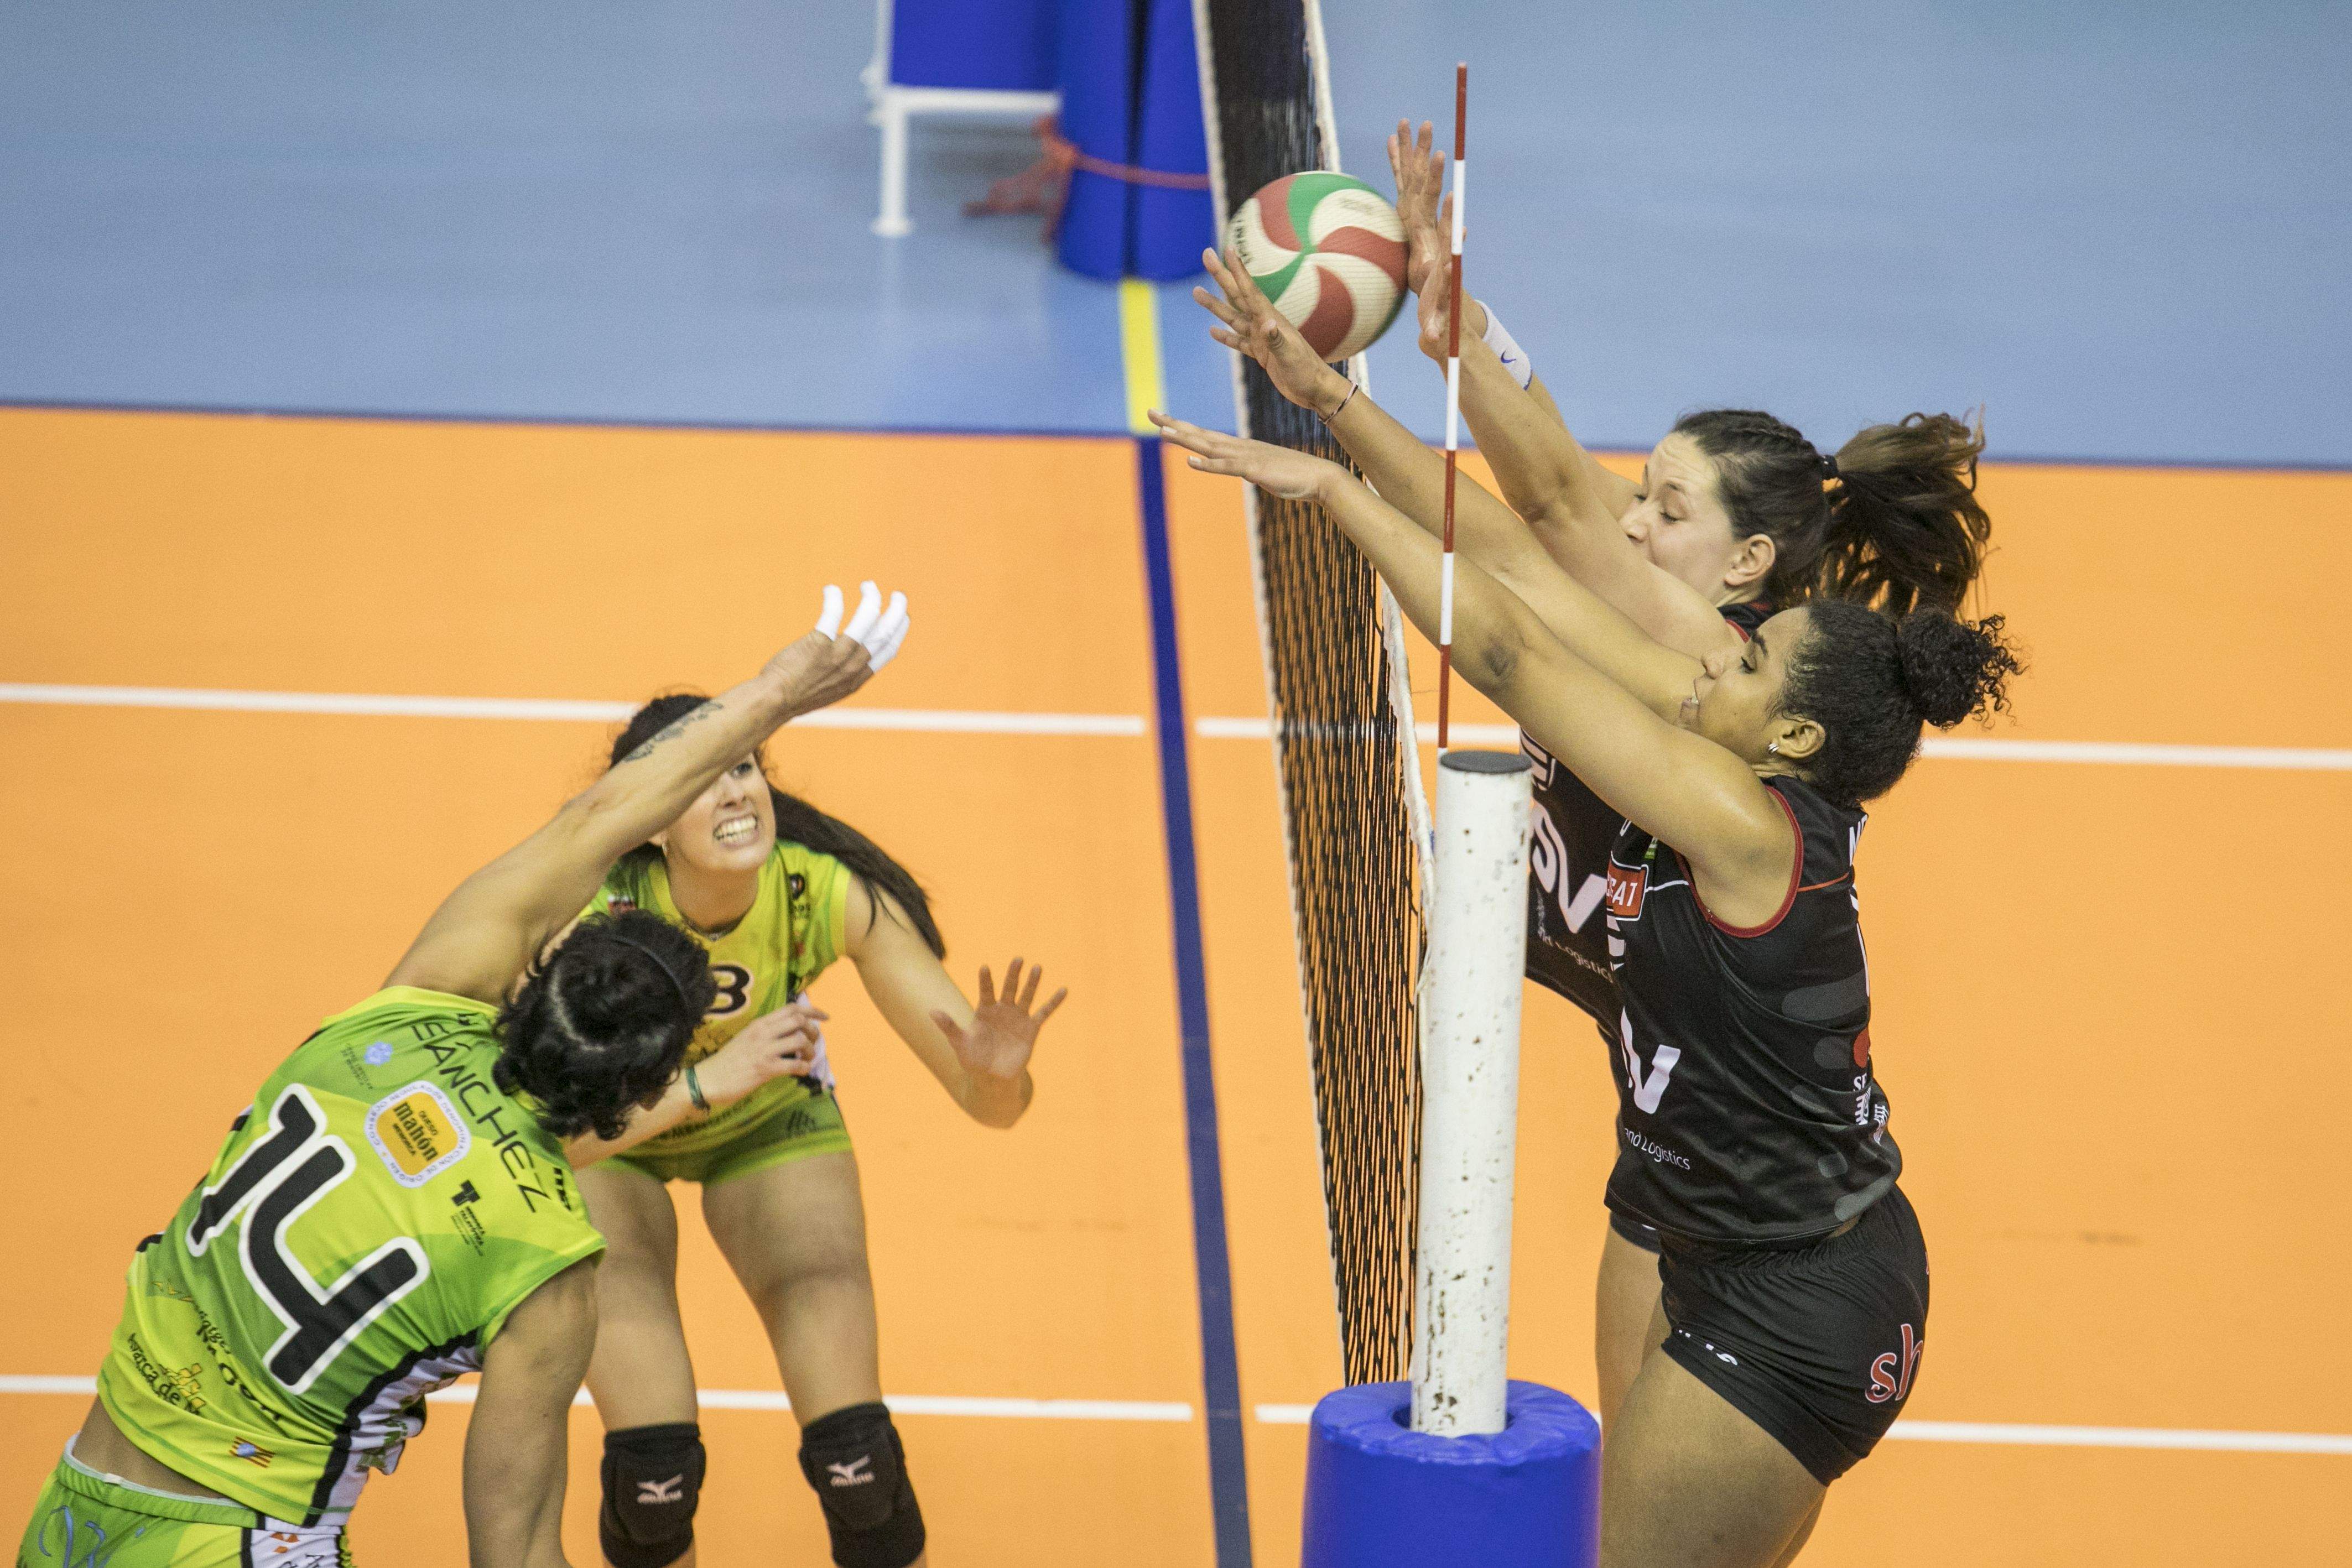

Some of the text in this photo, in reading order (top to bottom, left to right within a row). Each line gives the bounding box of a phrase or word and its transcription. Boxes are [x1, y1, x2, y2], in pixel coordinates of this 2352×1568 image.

[393, 1101, 438, 1161] mahón
[409, 1021, 551, 1213] SÁNCHEZ
[418, 1110, 438, 1135] QUESO
[185, 1082, 430, 1395] 14
